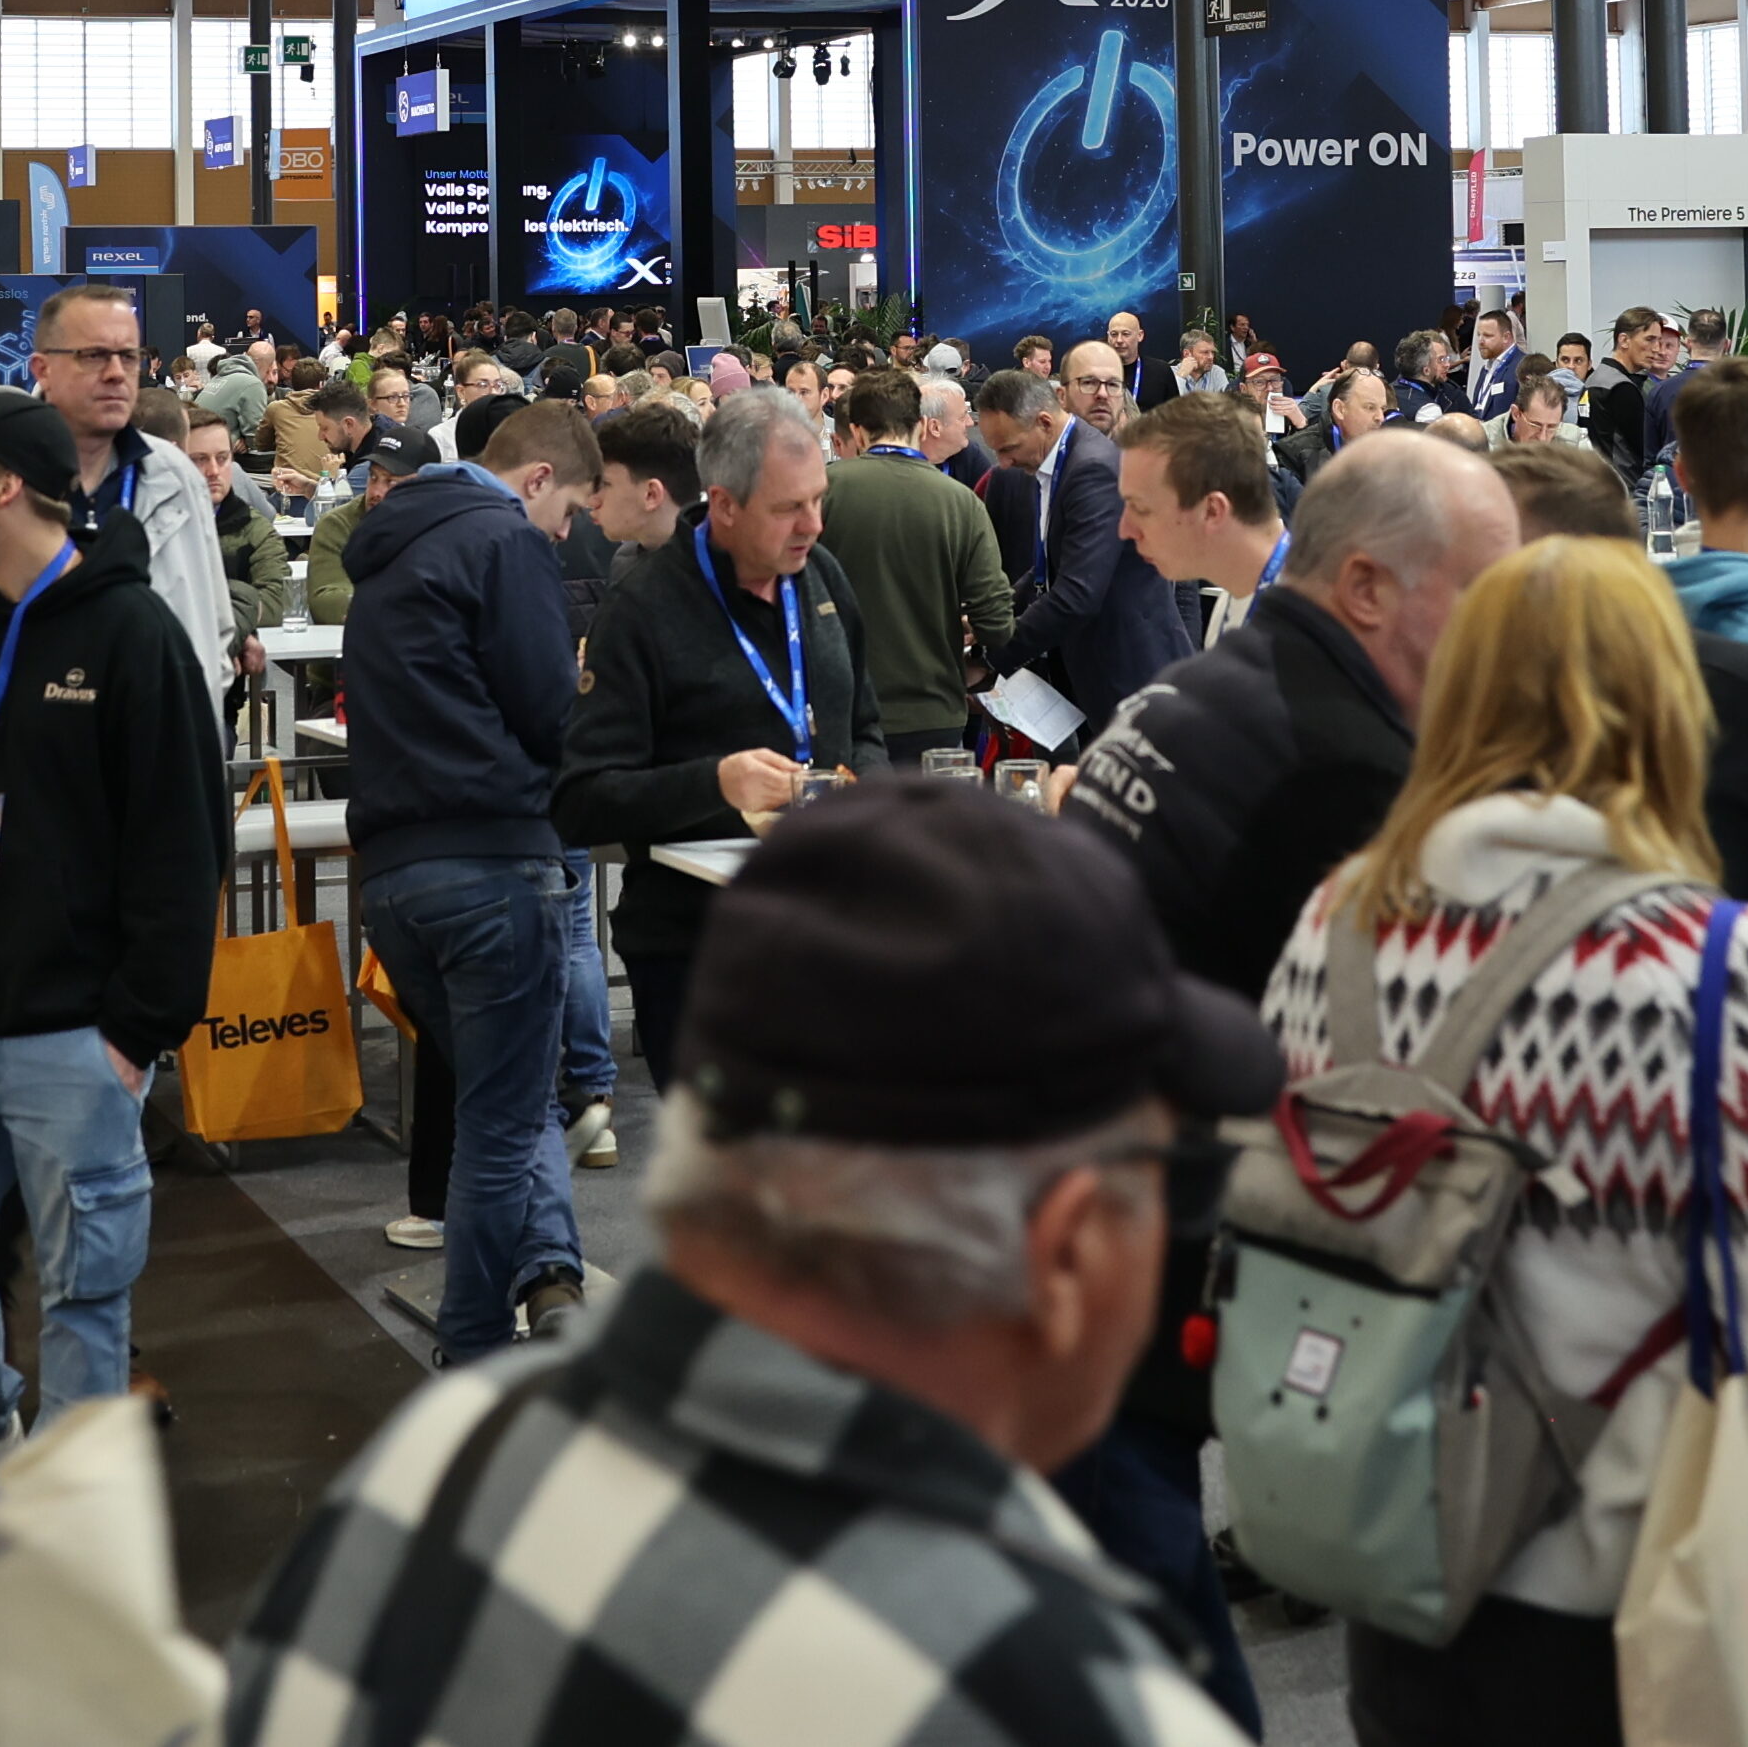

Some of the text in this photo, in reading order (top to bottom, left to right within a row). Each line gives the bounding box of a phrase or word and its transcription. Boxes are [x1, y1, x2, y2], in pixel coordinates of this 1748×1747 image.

[1255, 20, 1266, 29] EXIT
[1233, 132, 1428, 167] Power ON
[279, 152, 324, 168] OBO
[425, 169, 457, 179] Unser
[425, 183, 465, 197] Volle
[425, 201, 465, 215] Volle
[1628, 206, 1745, 222] The Premiere 5
[550, 219, 630, 233] elektrisch.
[201, 1009, 330, 1050] Televes
